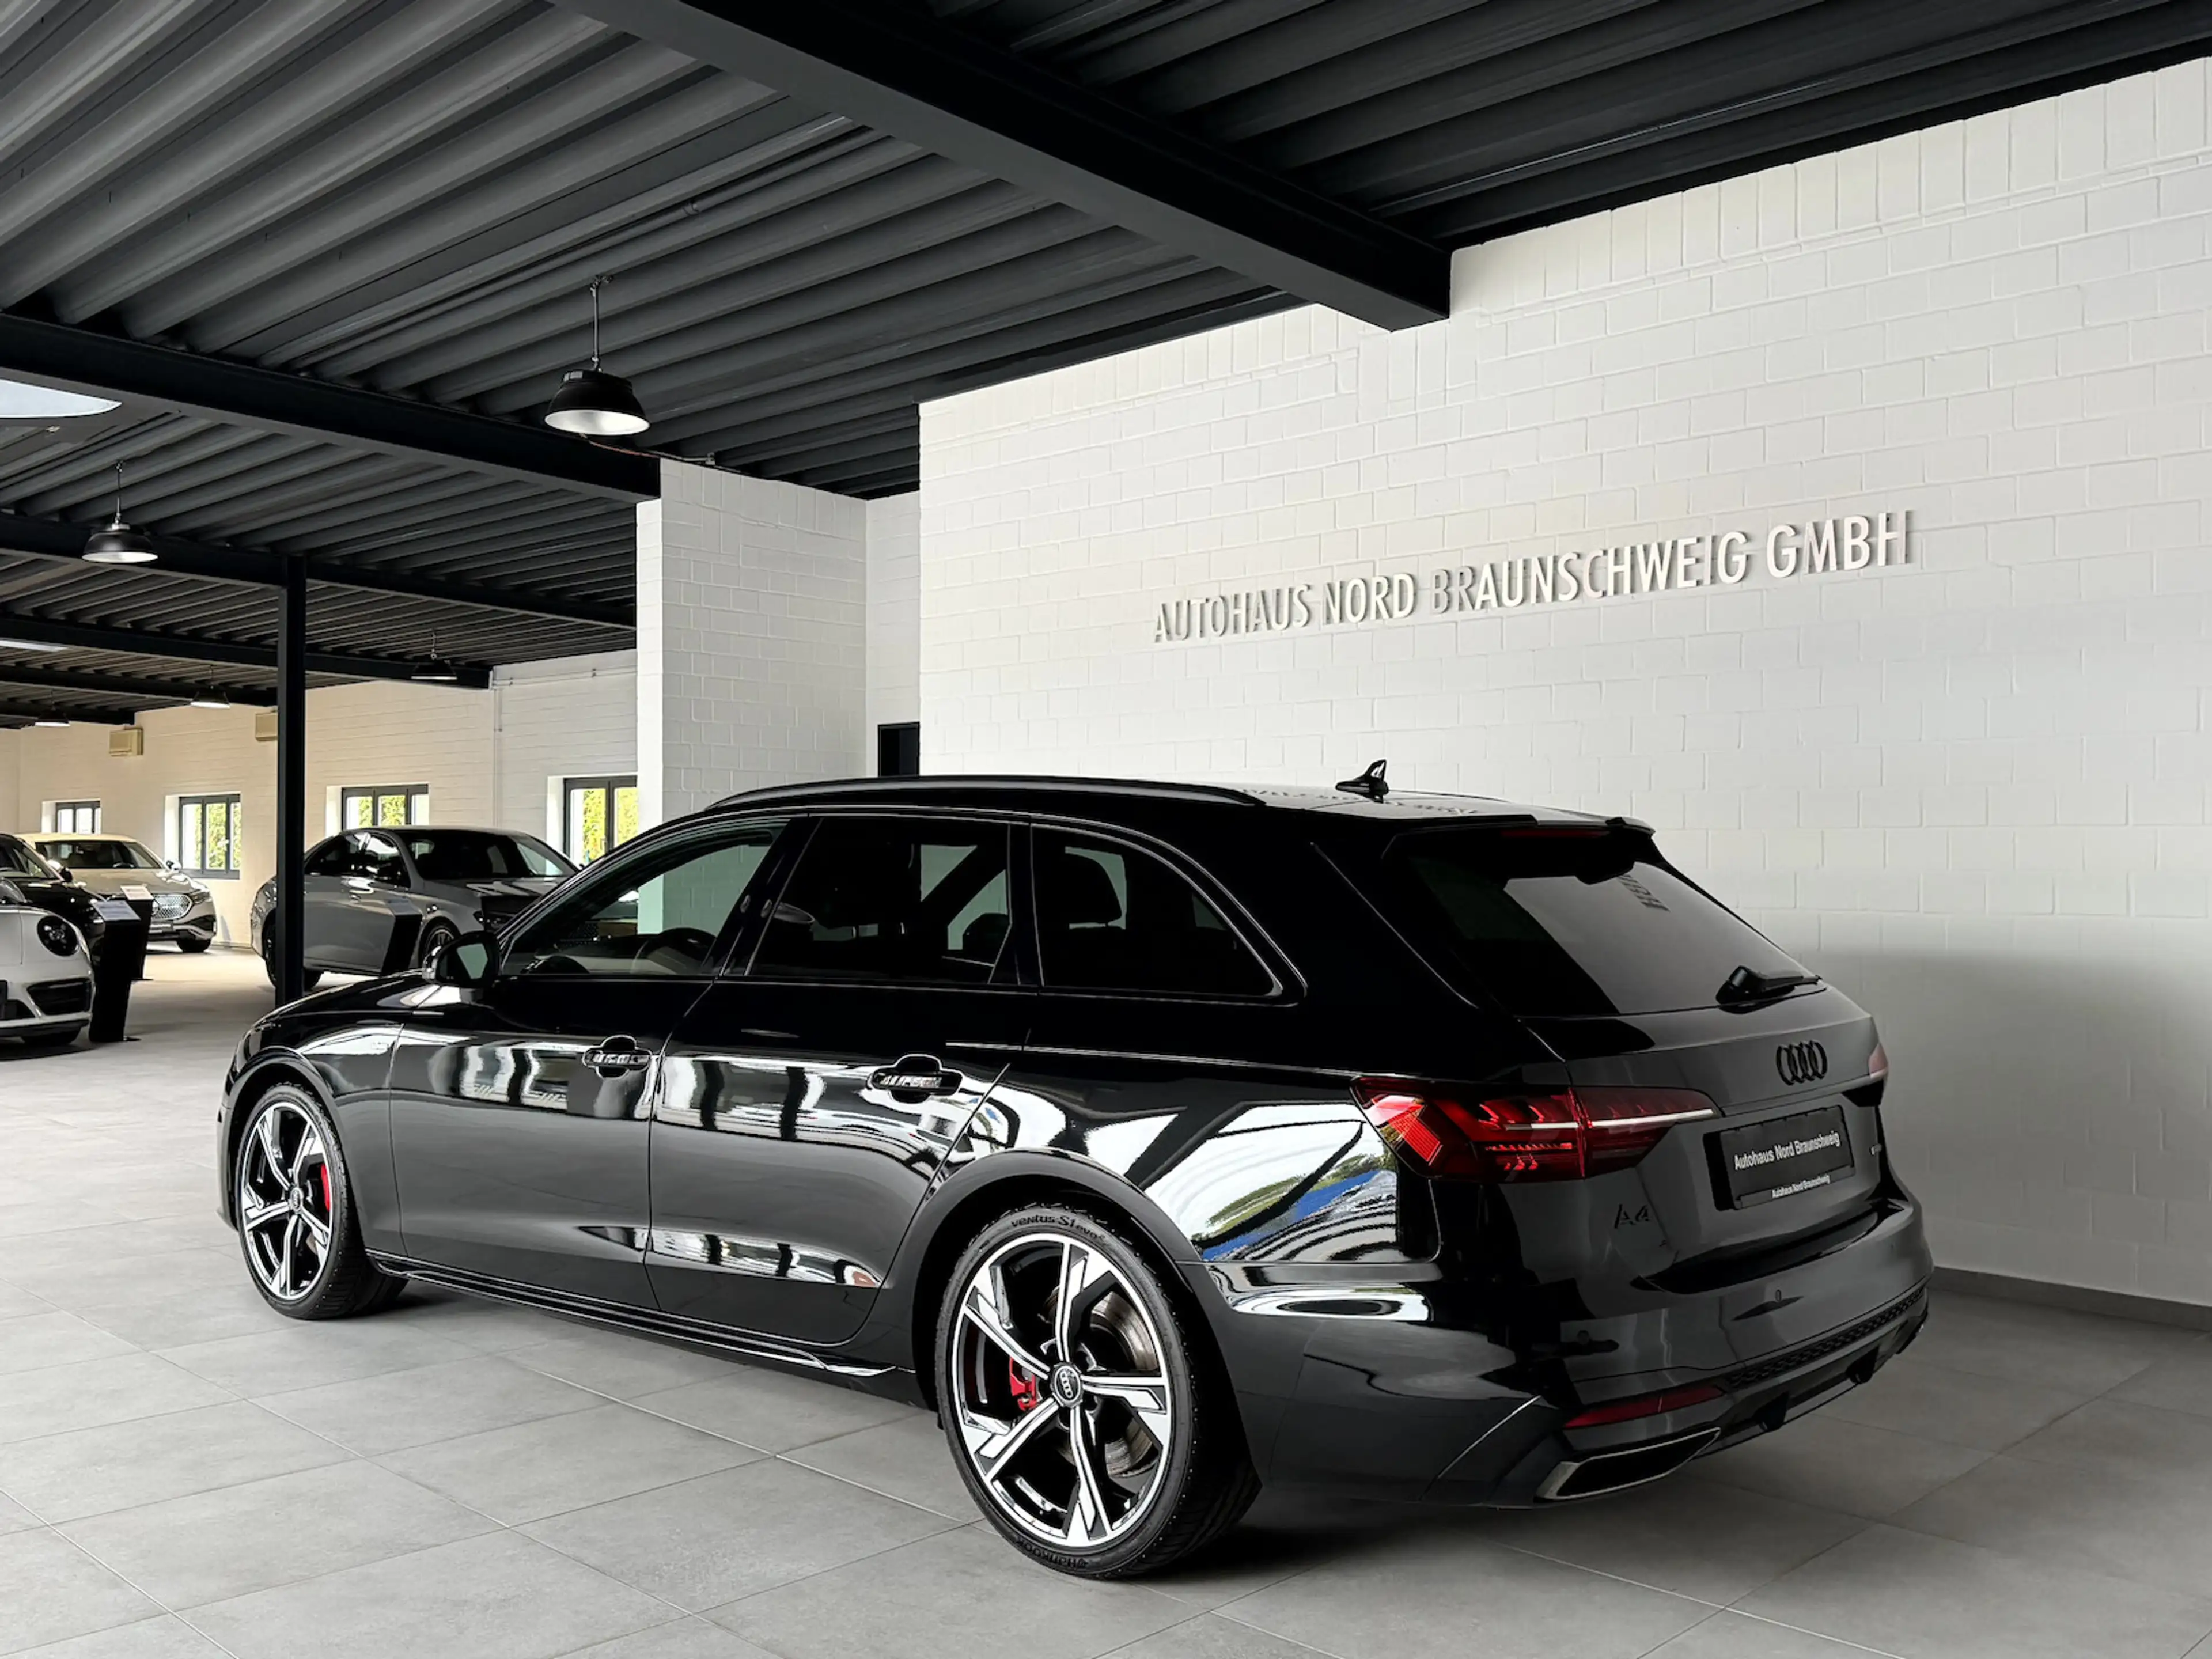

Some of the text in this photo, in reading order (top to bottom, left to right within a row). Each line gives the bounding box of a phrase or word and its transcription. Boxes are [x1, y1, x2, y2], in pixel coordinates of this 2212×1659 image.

[1154, 510, 1909, 643] AUTOHAUS NORD BRAUNSCHWEIG GMBH
[1734, 1130, 1840, 1170] Autohaus Nord Braunschweig
